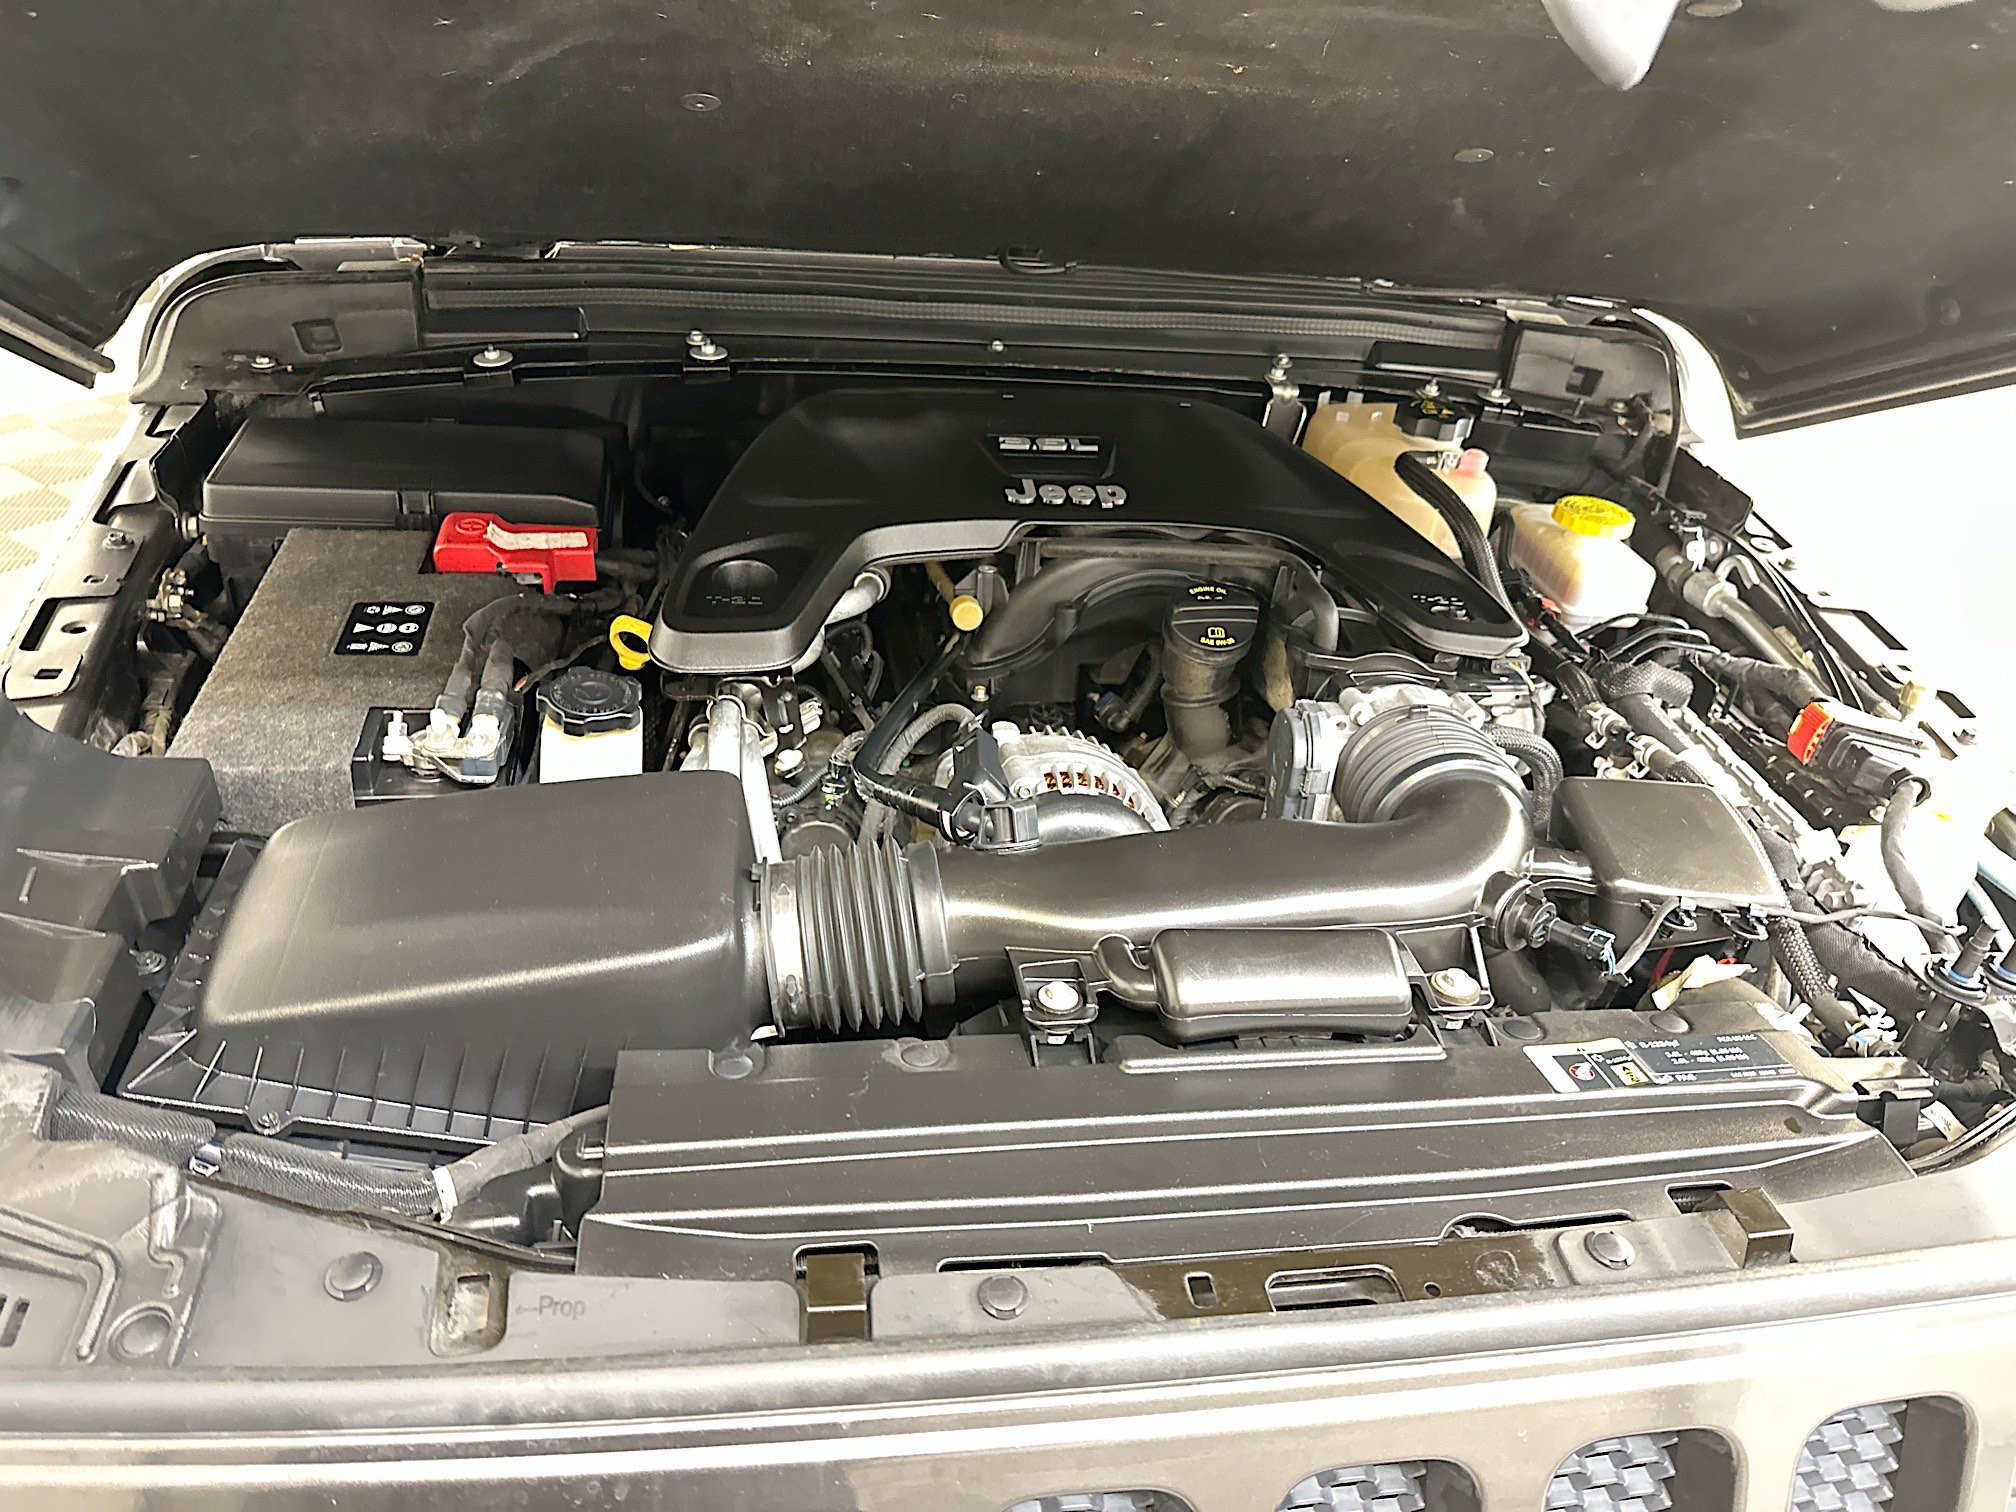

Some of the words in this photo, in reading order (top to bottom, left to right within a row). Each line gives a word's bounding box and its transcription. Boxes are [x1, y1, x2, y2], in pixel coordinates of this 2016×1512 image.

[1004, 478, 1127, 509] Jeep
[1188, 586, 1215, 595] ENGINE
[1216, 586, 1228, 595] OIL
[1200, 636, 1215, 646] SAE
[538, 1295, 587, 1320] Prop
